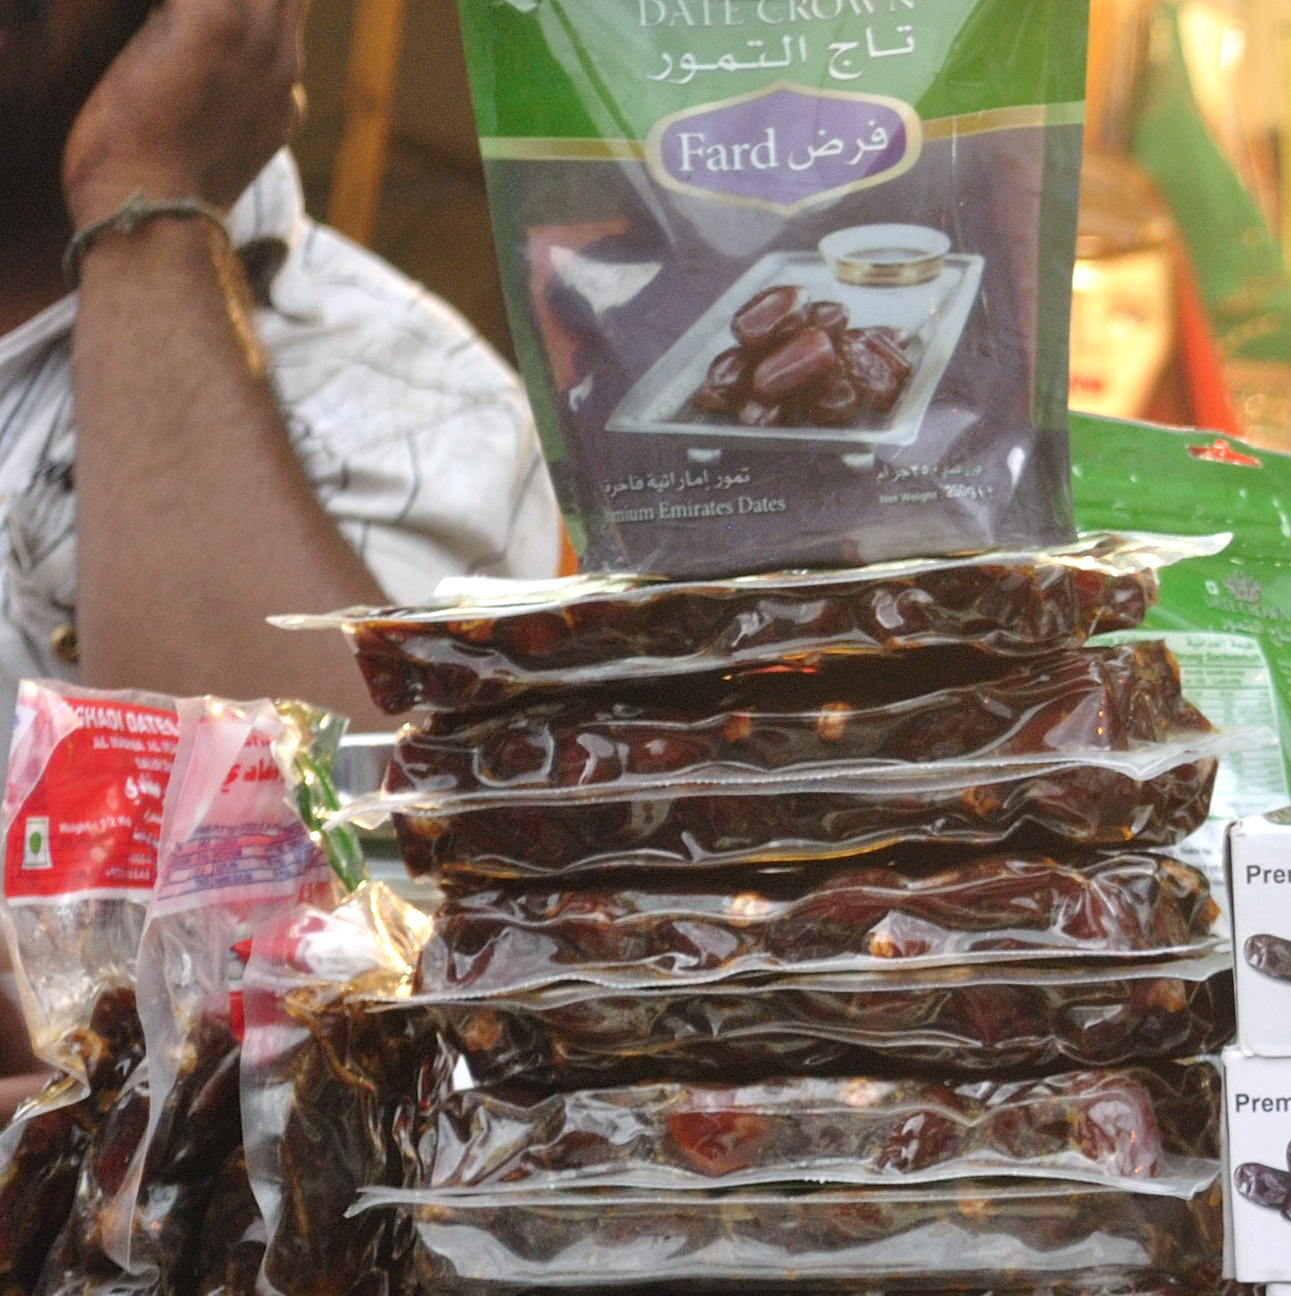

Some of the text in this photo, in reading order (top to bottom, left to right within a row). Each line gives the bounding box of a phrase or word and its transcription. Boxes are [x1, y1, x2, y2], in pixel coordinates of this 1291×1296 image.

[639, 0, 744, 26] DATE
[646, 25, 915, 84] تاج التمور
[677, 128, 778, 172] Fard
[788, 120, 889, 171] فرض
[659, 500, 733, 520] Emirates
[738, 496, 786, 514] Dates
